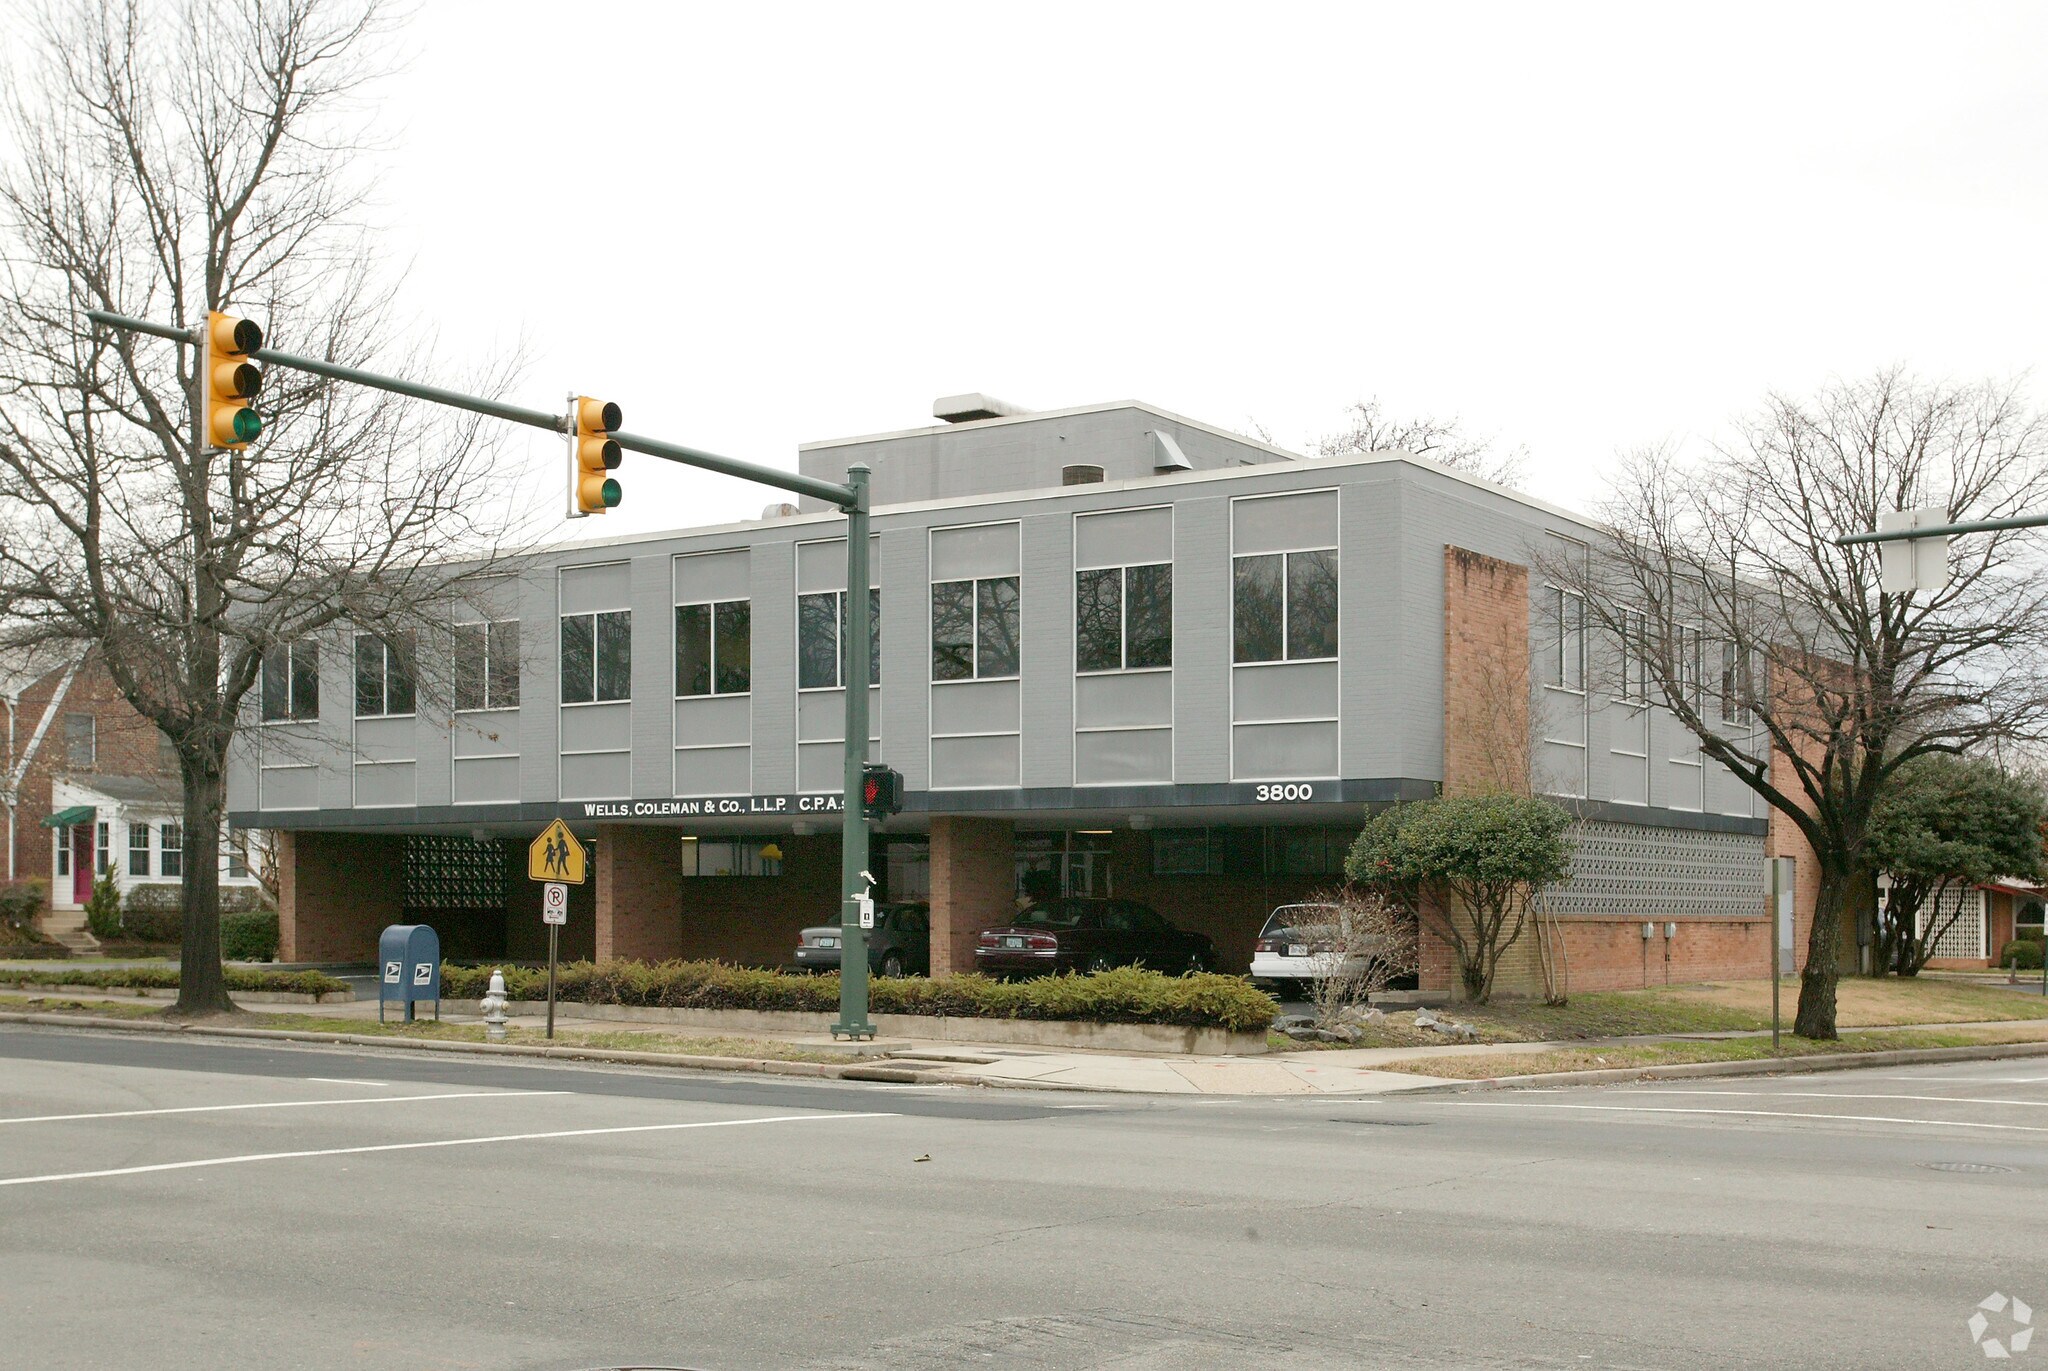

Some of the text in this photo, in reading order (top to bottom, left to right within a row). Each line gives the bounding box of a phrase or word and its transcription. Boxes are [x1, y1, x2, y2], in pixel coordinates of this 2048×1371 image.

[1256, 784, 1313, 801] 3800
[584, 804, 632, 816] WELLS,
[634, 802, 700, 815] COLEMAN
[704, 800, 715, 813] &
[751, 798, 786, 812] L.L.P.
[552, 891, 560, 902] P
